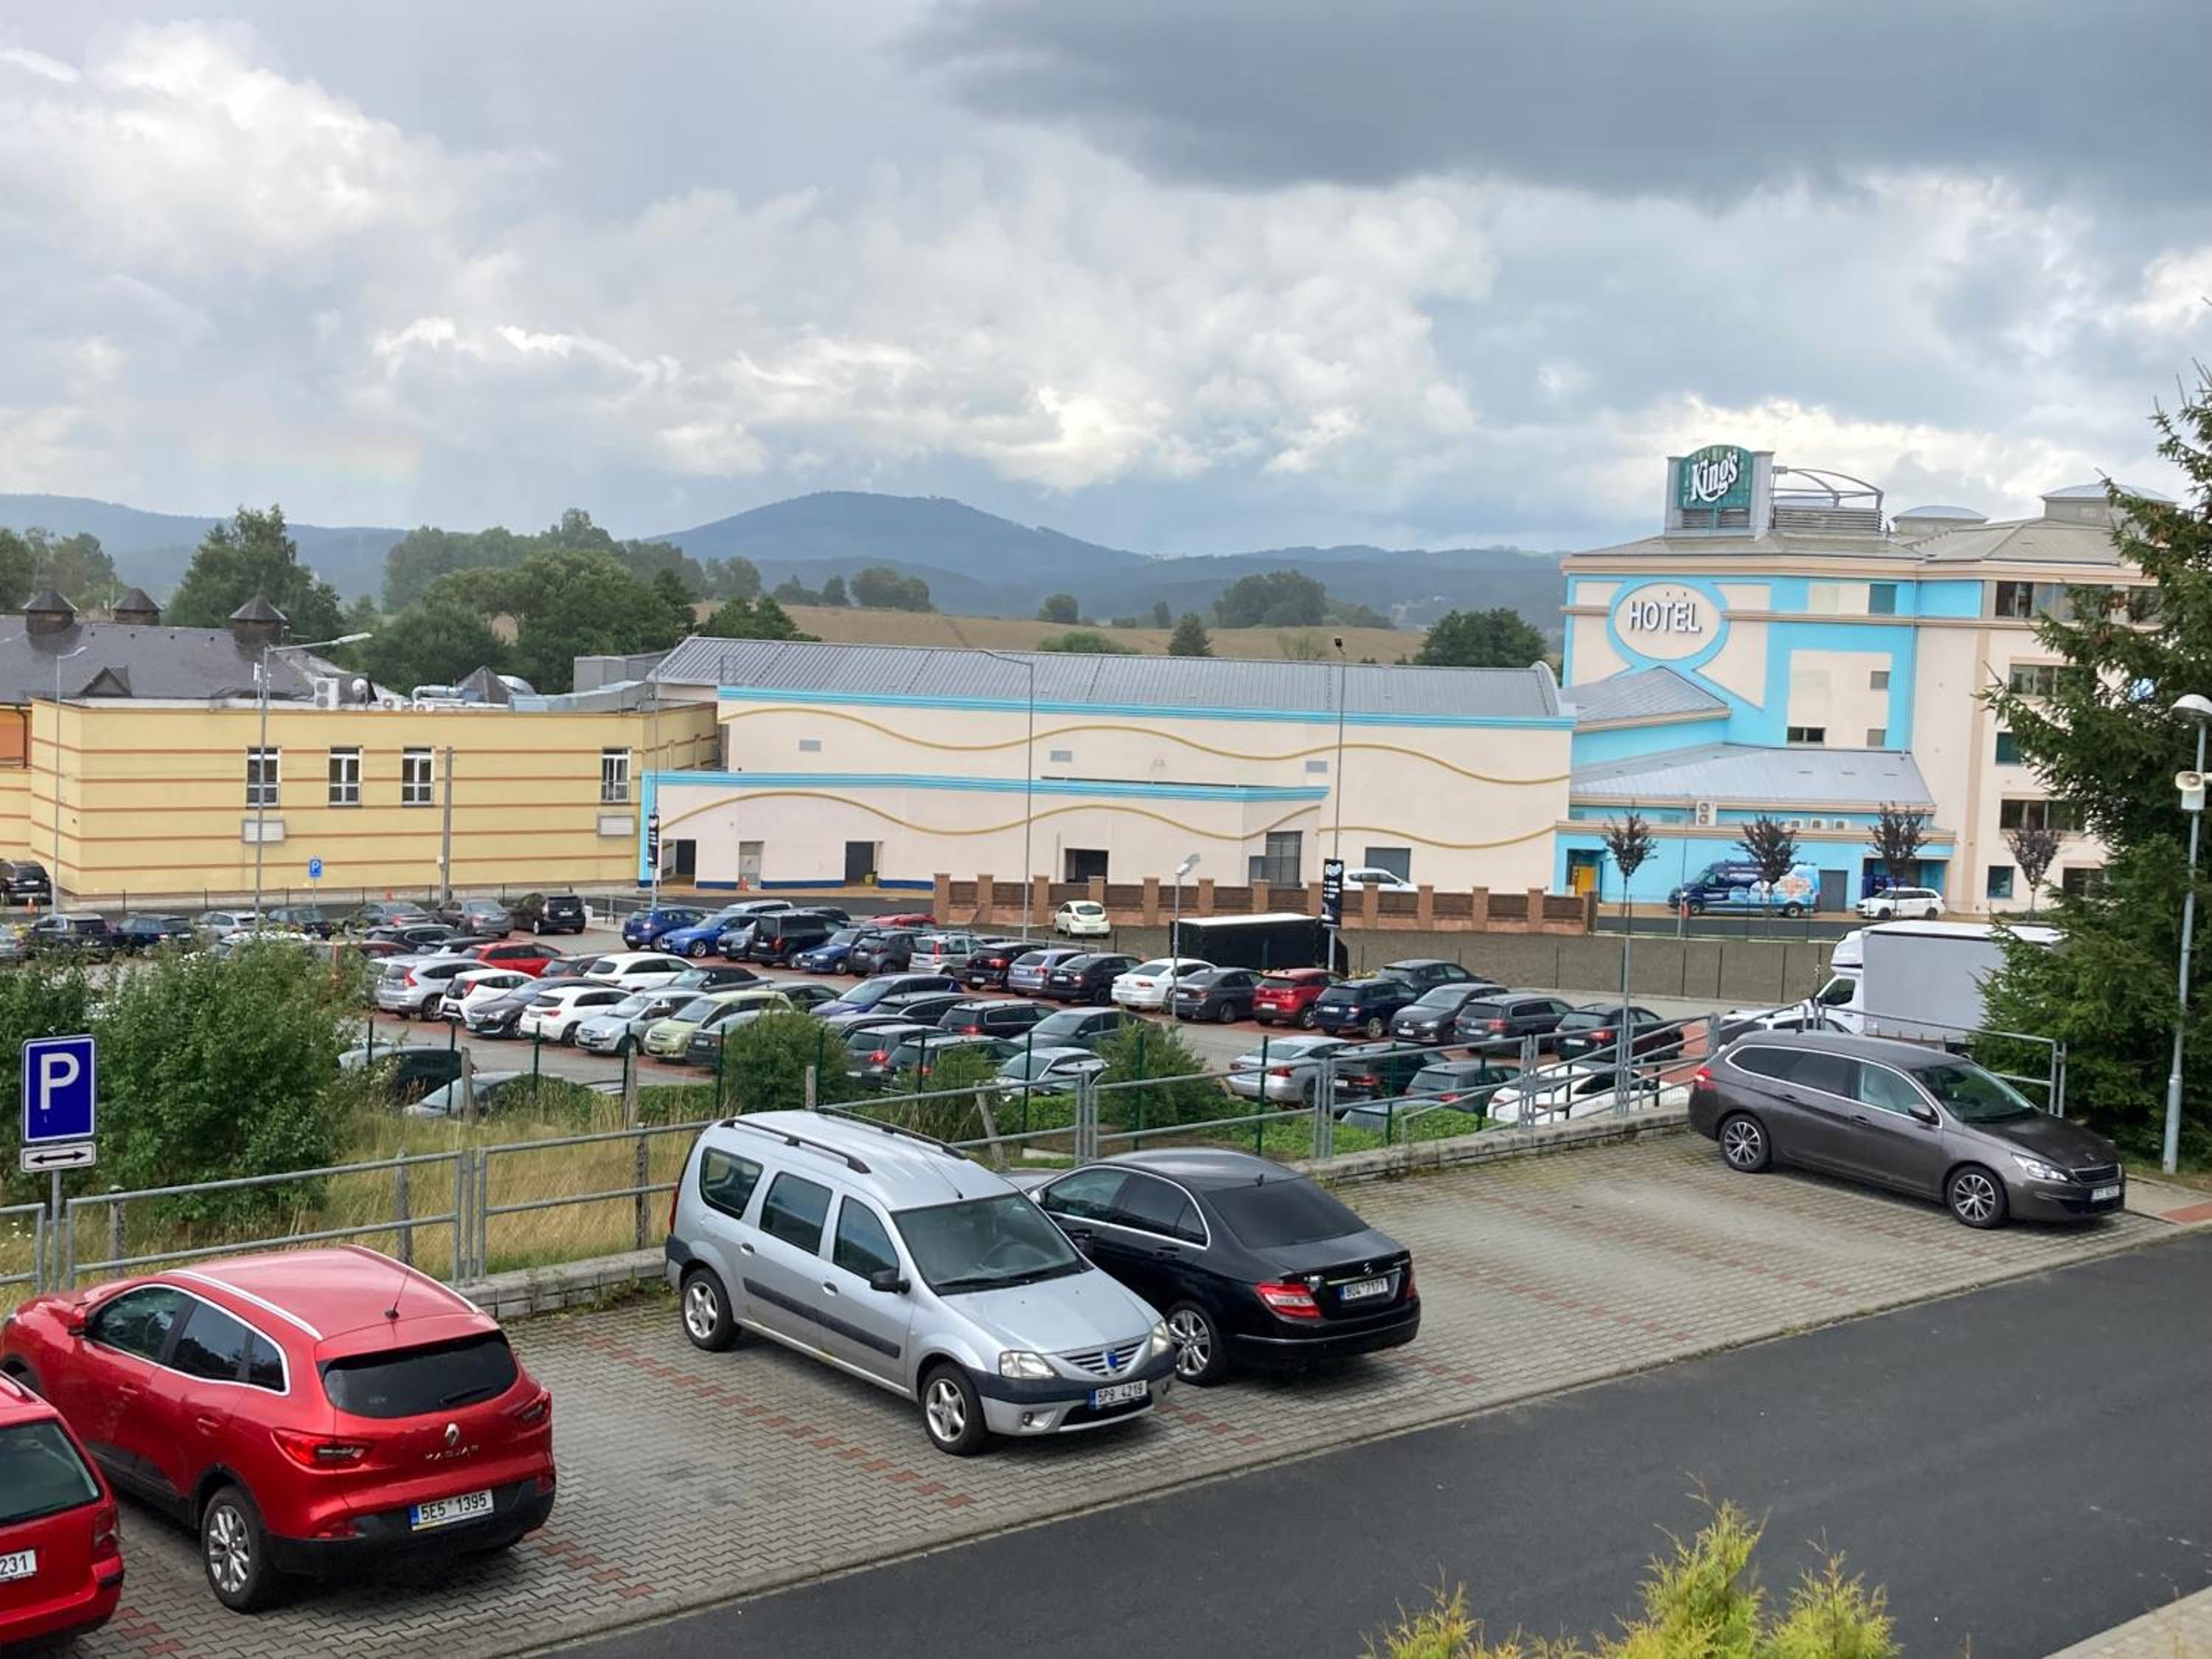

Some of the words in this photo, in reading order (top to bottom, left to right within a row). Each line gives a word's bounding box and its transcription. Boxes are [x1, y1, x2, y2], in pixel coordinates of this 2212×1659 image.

[1689, 451, 1739, 503] King's
[1628, 601, 1702, 633] HOTEL
[40, 1052, 80, 1110] P
[421, 1501, 446, 1520] 5E5
[456, 1492, 487, 1512] 1395
